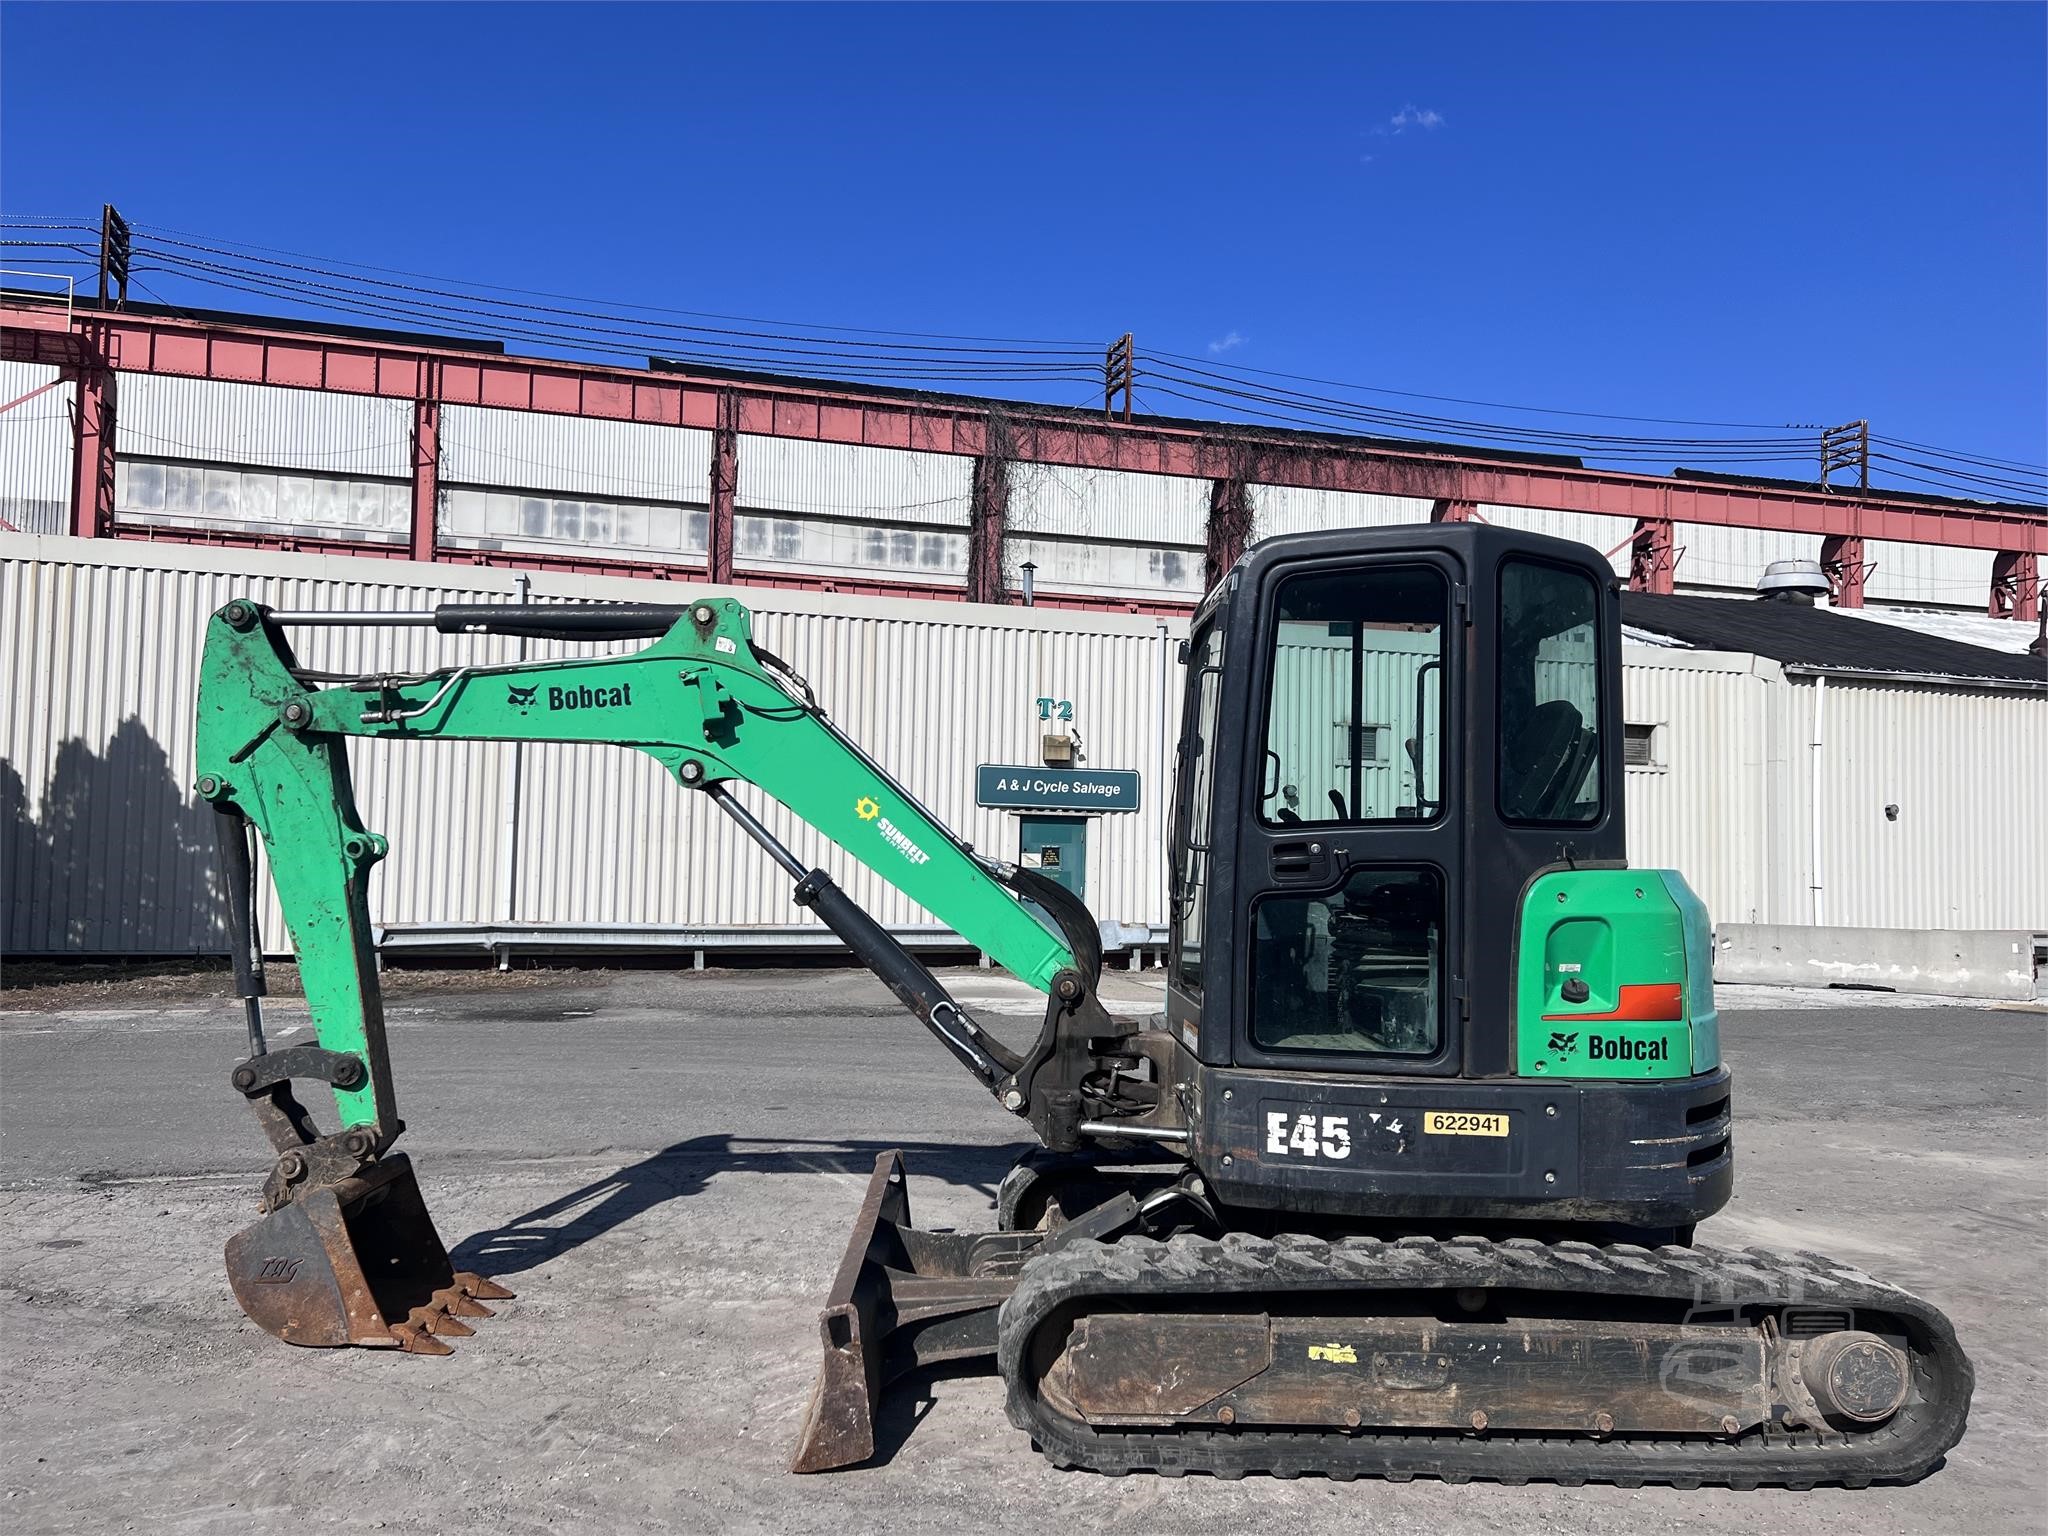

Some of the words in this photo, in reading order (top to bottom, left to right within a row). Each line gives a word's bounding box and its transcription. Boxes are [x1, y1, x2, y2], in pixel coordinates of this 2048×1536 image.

[548, 683, 632, 711] Bobcat
[1036, 697, 1073, 721] T2
[997, 779, 1007, 791] A
[1010, 779, 1020, 791] &
[1022, 780, 1031, 791] J
[1034, 780, 1069, 795] Cycle
[1072, 781, 1121, 797] Salvage
[877, 817, 931, 865] SUNBELT
[1588, 1035, 1668, 1061] Bobcat
[1267, 1111, 1351, 1159] E45
[1433, 1115, 1500, 1132] 622941
